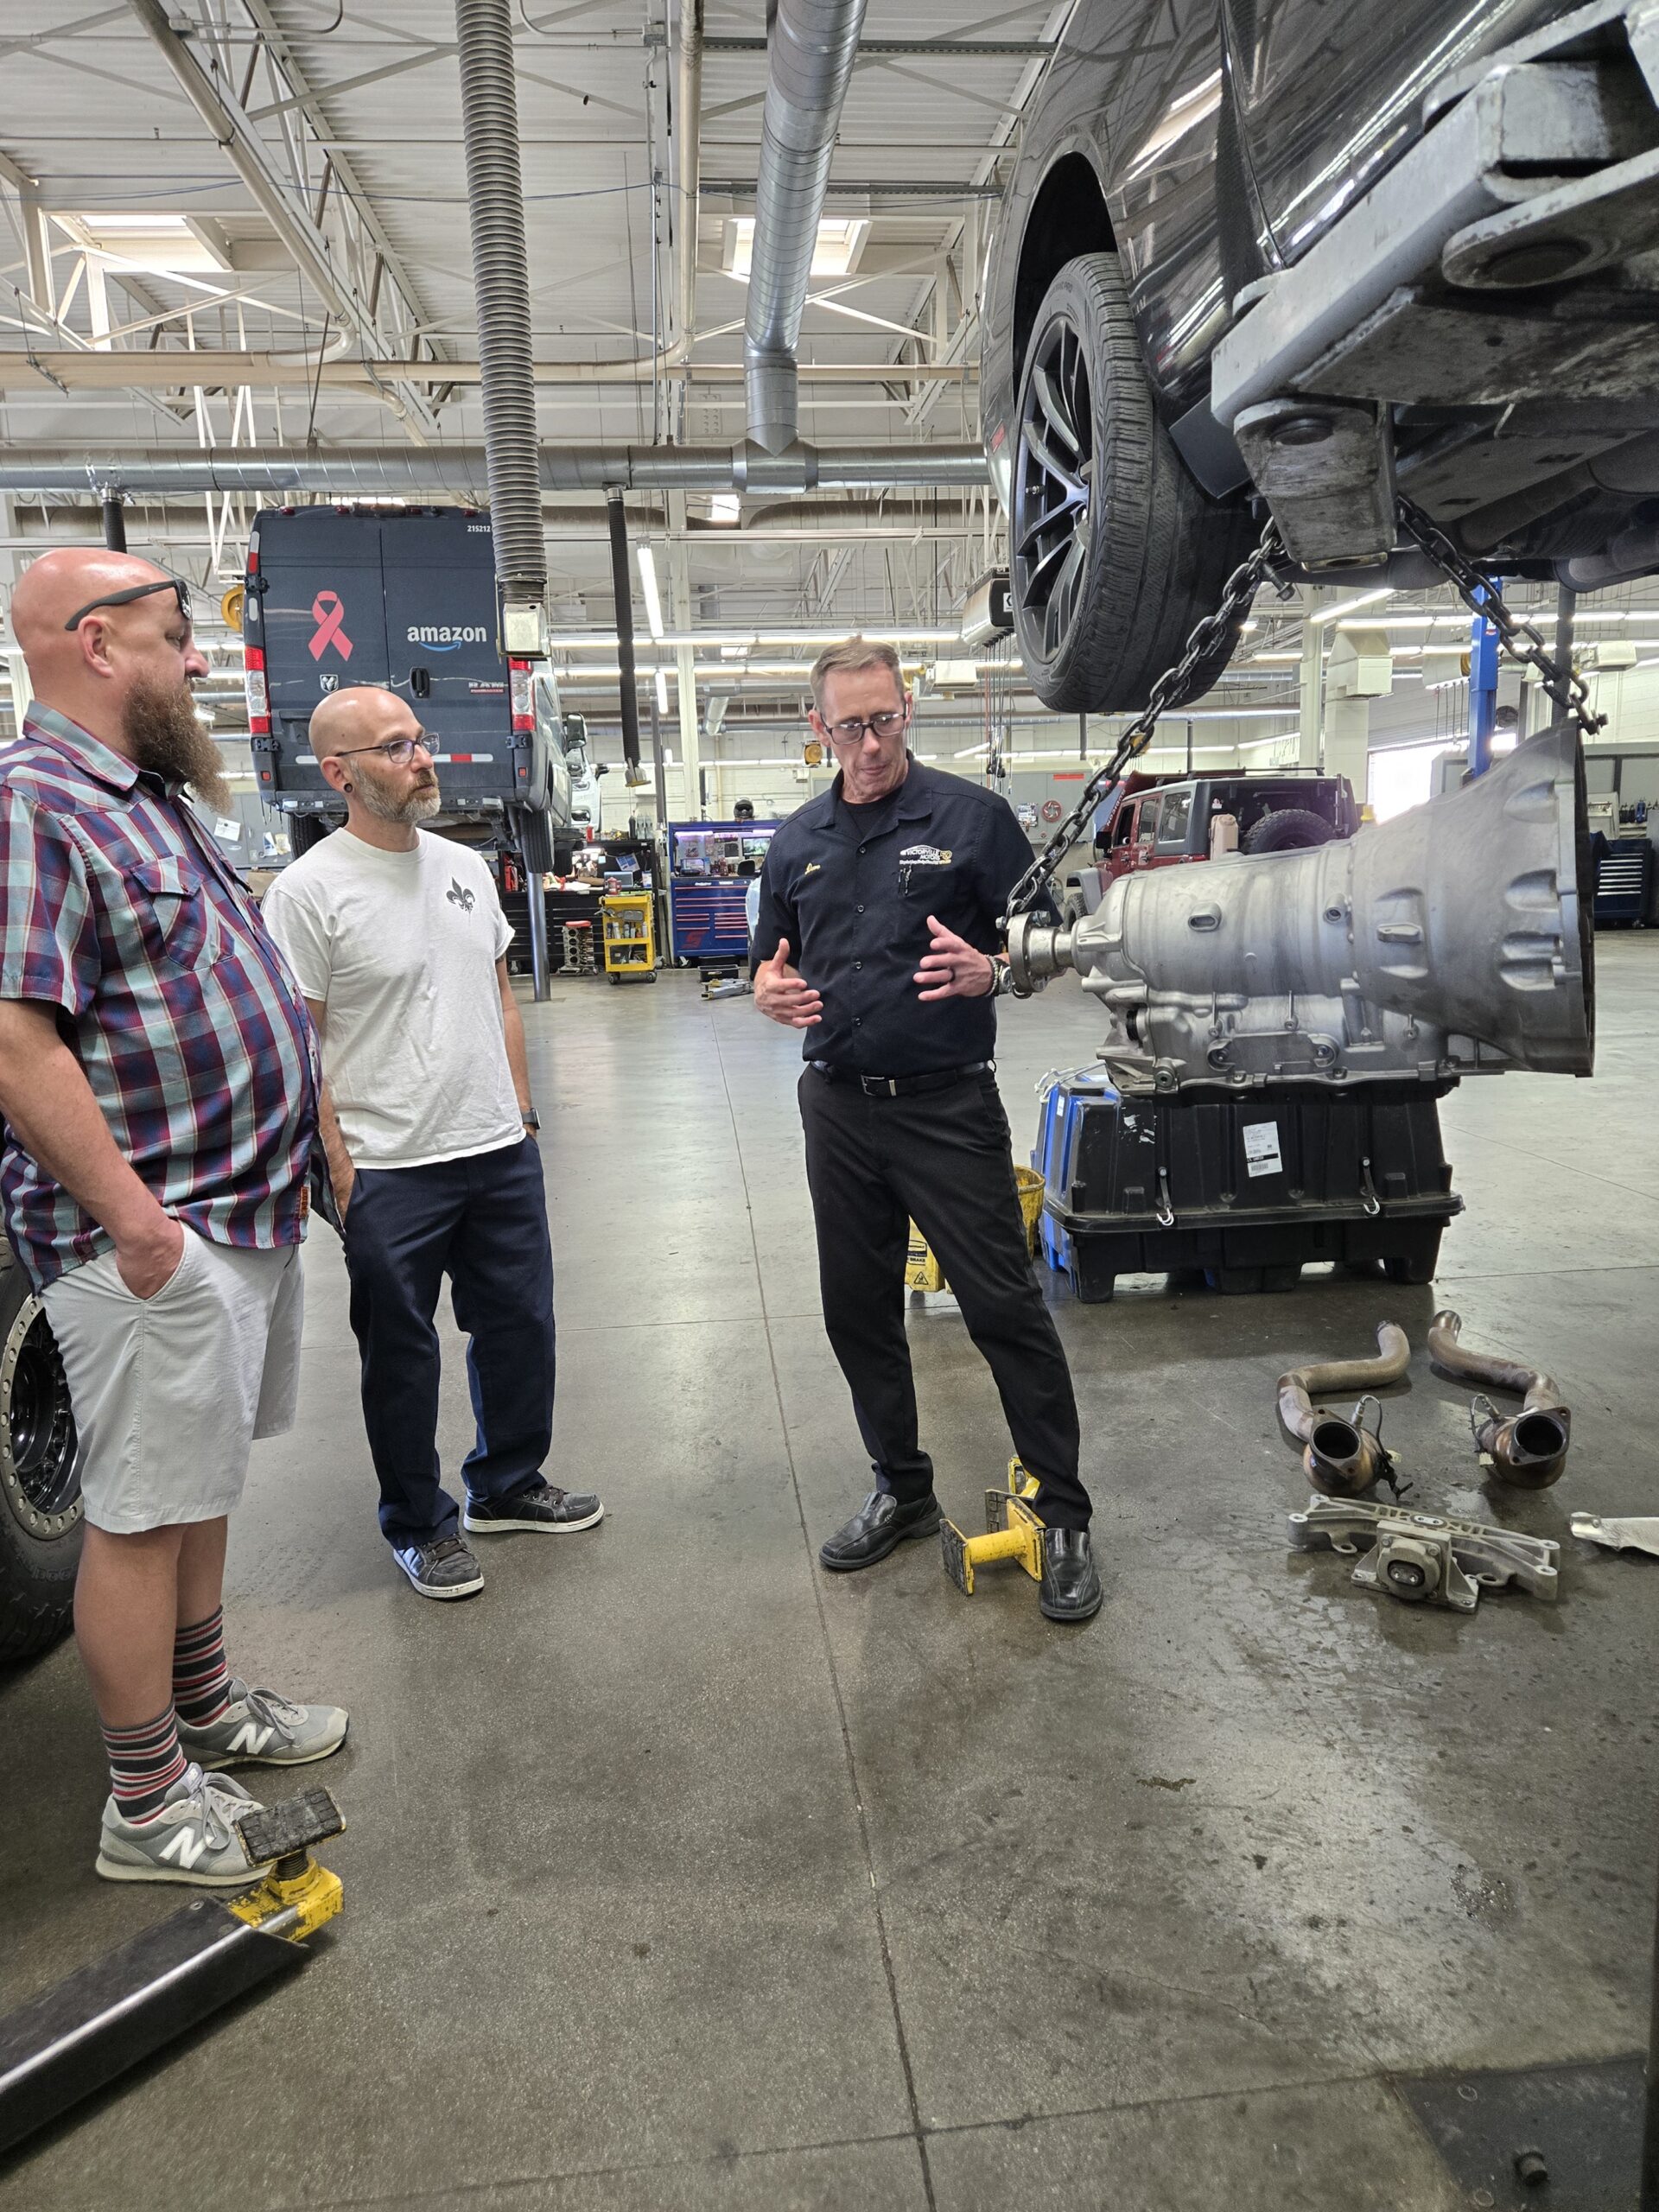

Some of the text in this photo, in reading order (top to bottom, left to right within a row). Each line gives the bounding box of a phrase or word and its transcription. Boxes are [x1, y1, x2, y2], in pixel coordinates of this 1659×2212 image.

[407, 626, 487, 642] amazon
[226, 1722, 276, 1755] N
[159, 1826, 216, 1869] N
